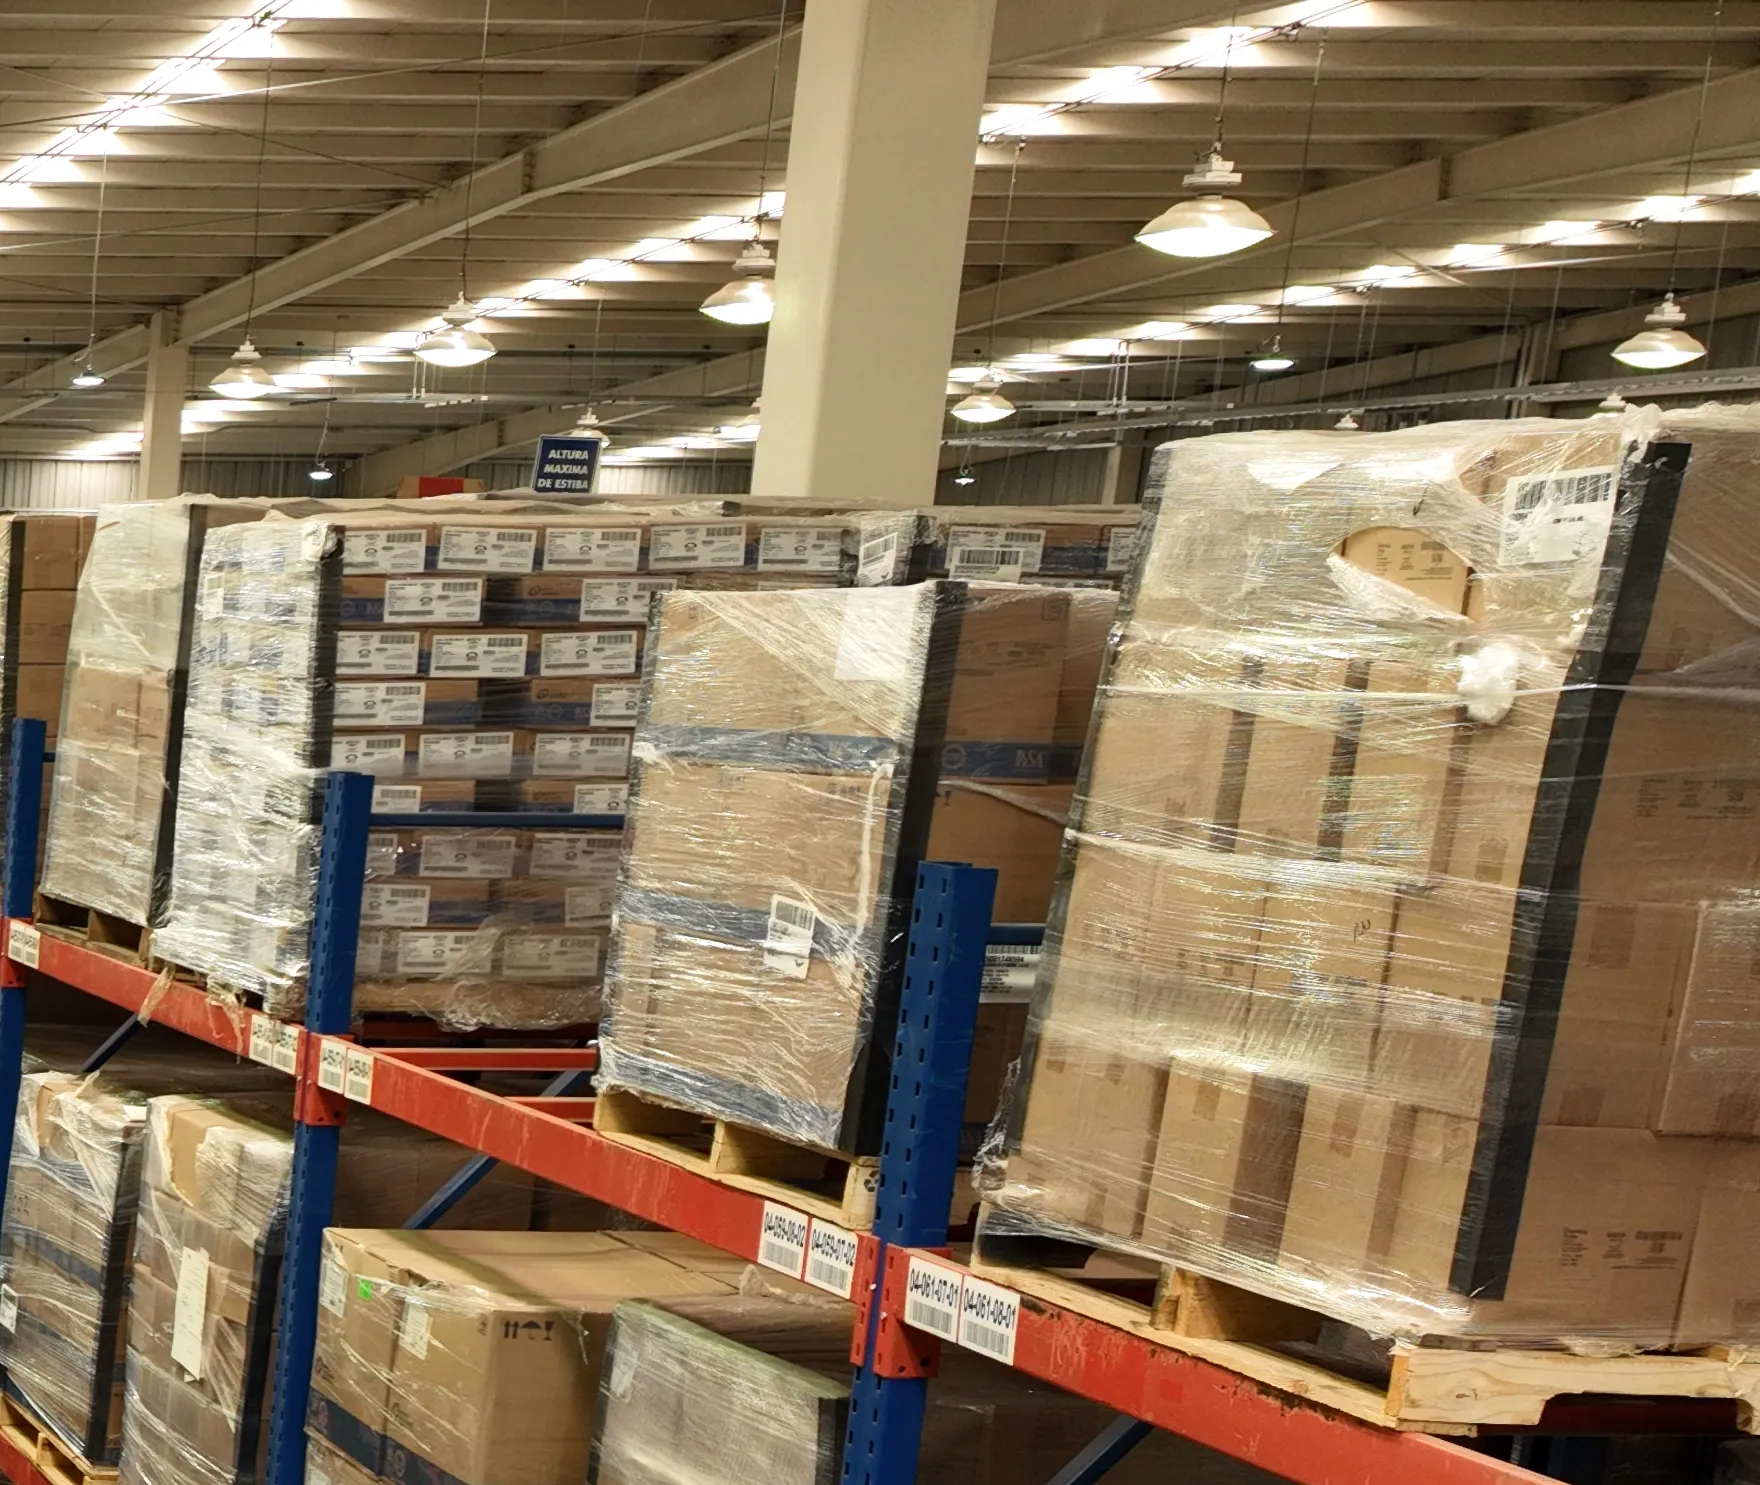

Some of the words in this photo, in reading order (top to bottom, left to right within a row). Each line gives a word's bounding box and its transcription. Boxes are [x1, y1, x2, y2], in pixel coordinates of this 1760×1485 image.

[548, 449, 589, 460] ALTURA
[543, 464, 589, 475] MAXIMA
[537, 478, 552, 488] DE
[554, 479, 588, 489] ESTIBA
[811, 1228, 856, 1267] 04-059-07-02
[910, 1268, 958, 1309] 04-061-07-01
[964, 1287, 1016, 1329] 04-061-08-01
